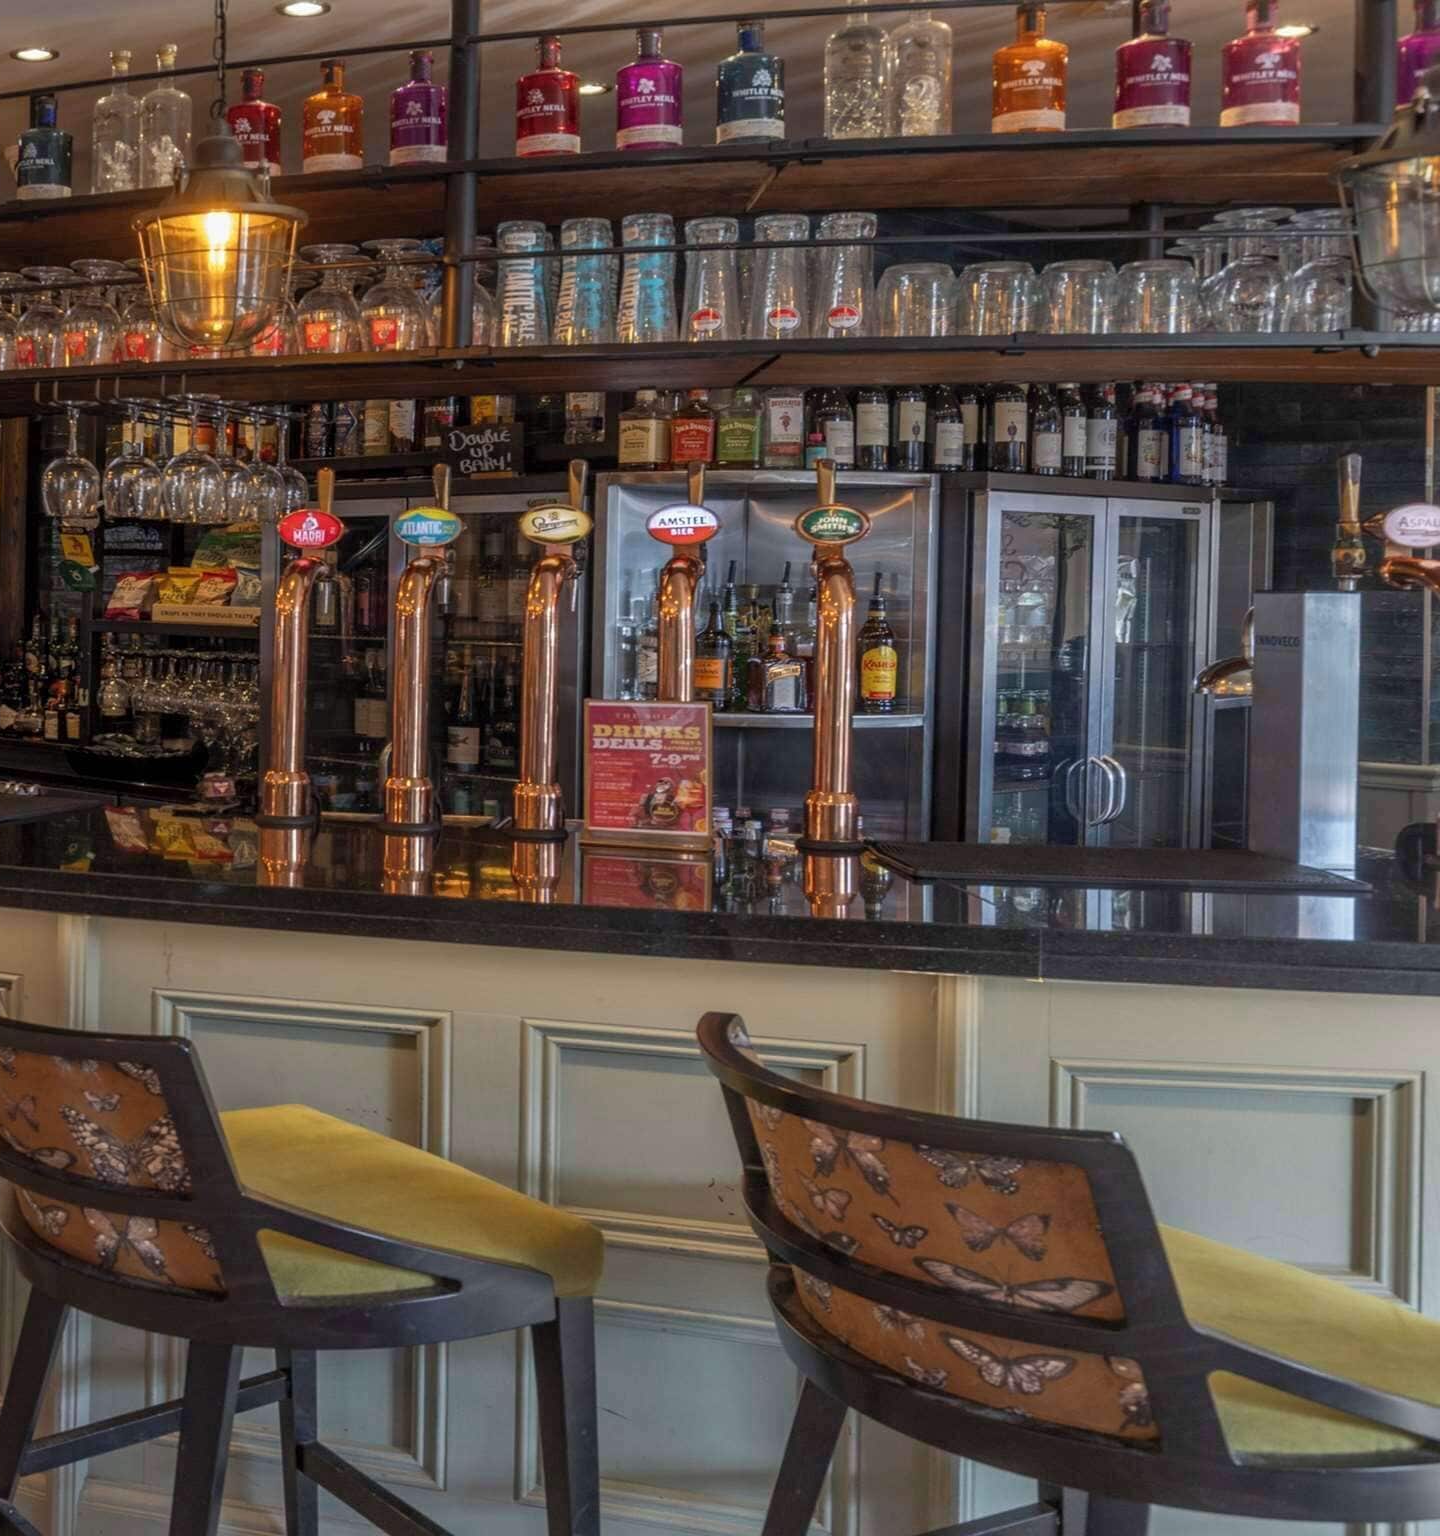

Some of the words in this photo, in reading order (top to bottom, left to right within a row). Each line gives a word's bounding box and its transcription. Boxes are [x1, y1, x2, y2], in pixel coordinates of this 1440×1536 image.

[658, 516, 707, 527] AMSTEL
[817, 516, 848, 527] JOHN
[670, 527, 695, 536] BIER
[592, 724, 701, 740] DRINKS
[592, 738, 663, 751] DEALS
